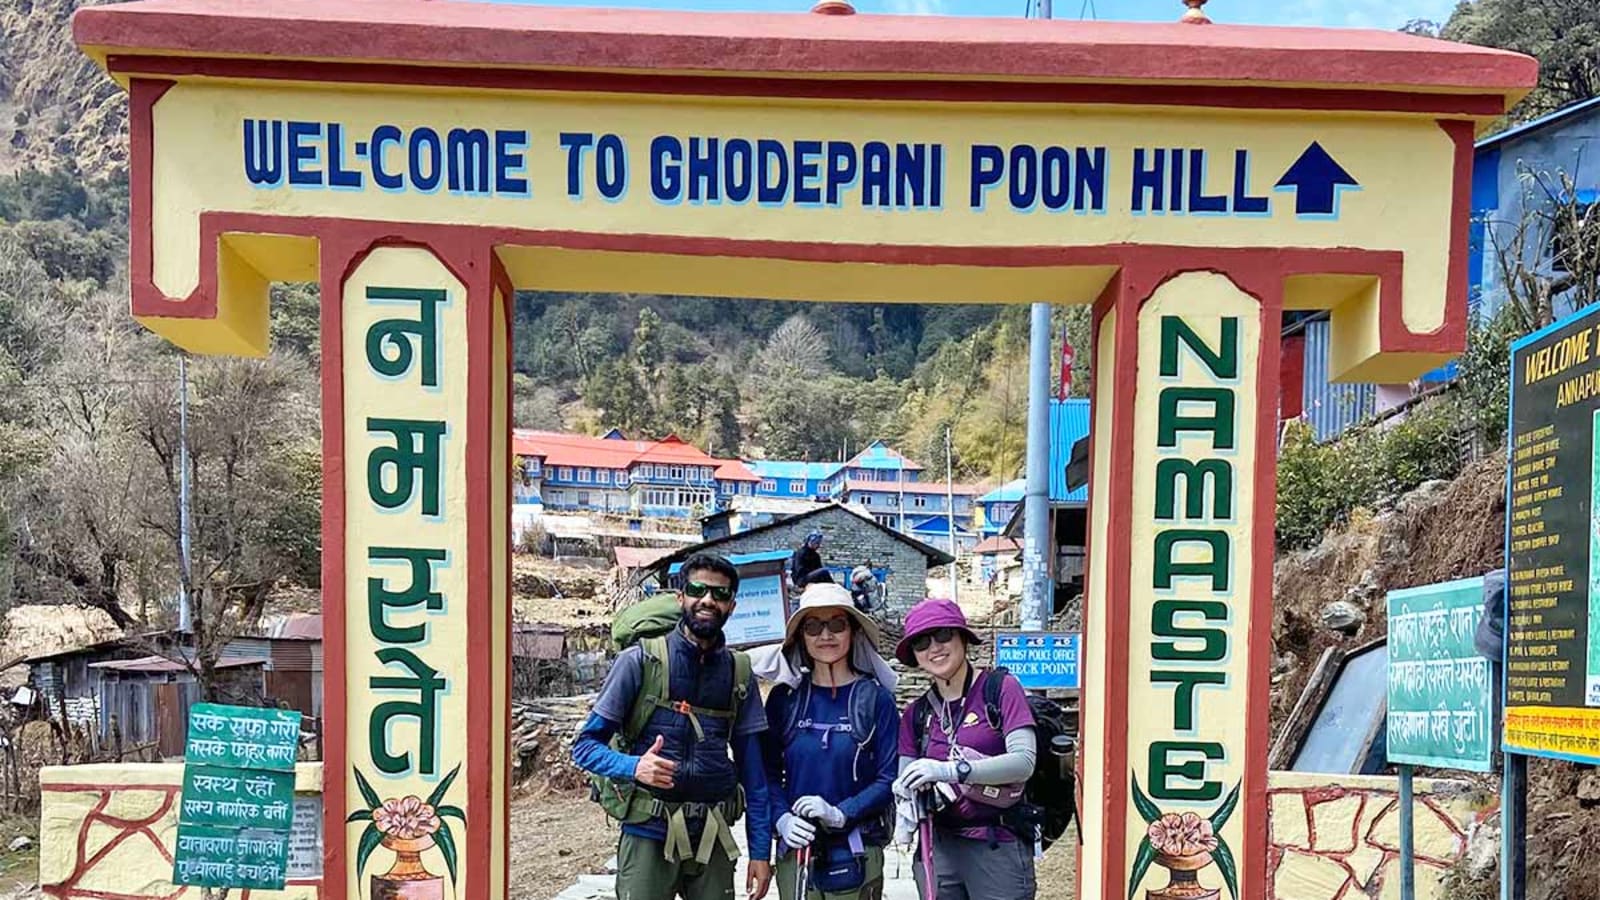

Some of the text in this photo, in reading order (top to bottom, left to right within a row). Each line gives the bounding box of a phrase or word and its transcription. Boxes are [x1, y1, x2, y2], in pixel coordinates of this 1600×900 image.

[560, 132, 625, 198] TO
[650, 135, 942, 208] GHODEPANI
[970, 145, 1106, 210] POON
[1131, 148, 1269, 213] HILL
[1525, 328, 1593, 385] WELCOME
[1556, 368, 1600, 408] ANNAPU
[1148, 315, 1239, 801] NAMASTE
[1000, 649, 1075, 661] TOURIST POLICE OFFICE
[1041, 662, 1076, 674] POINT
